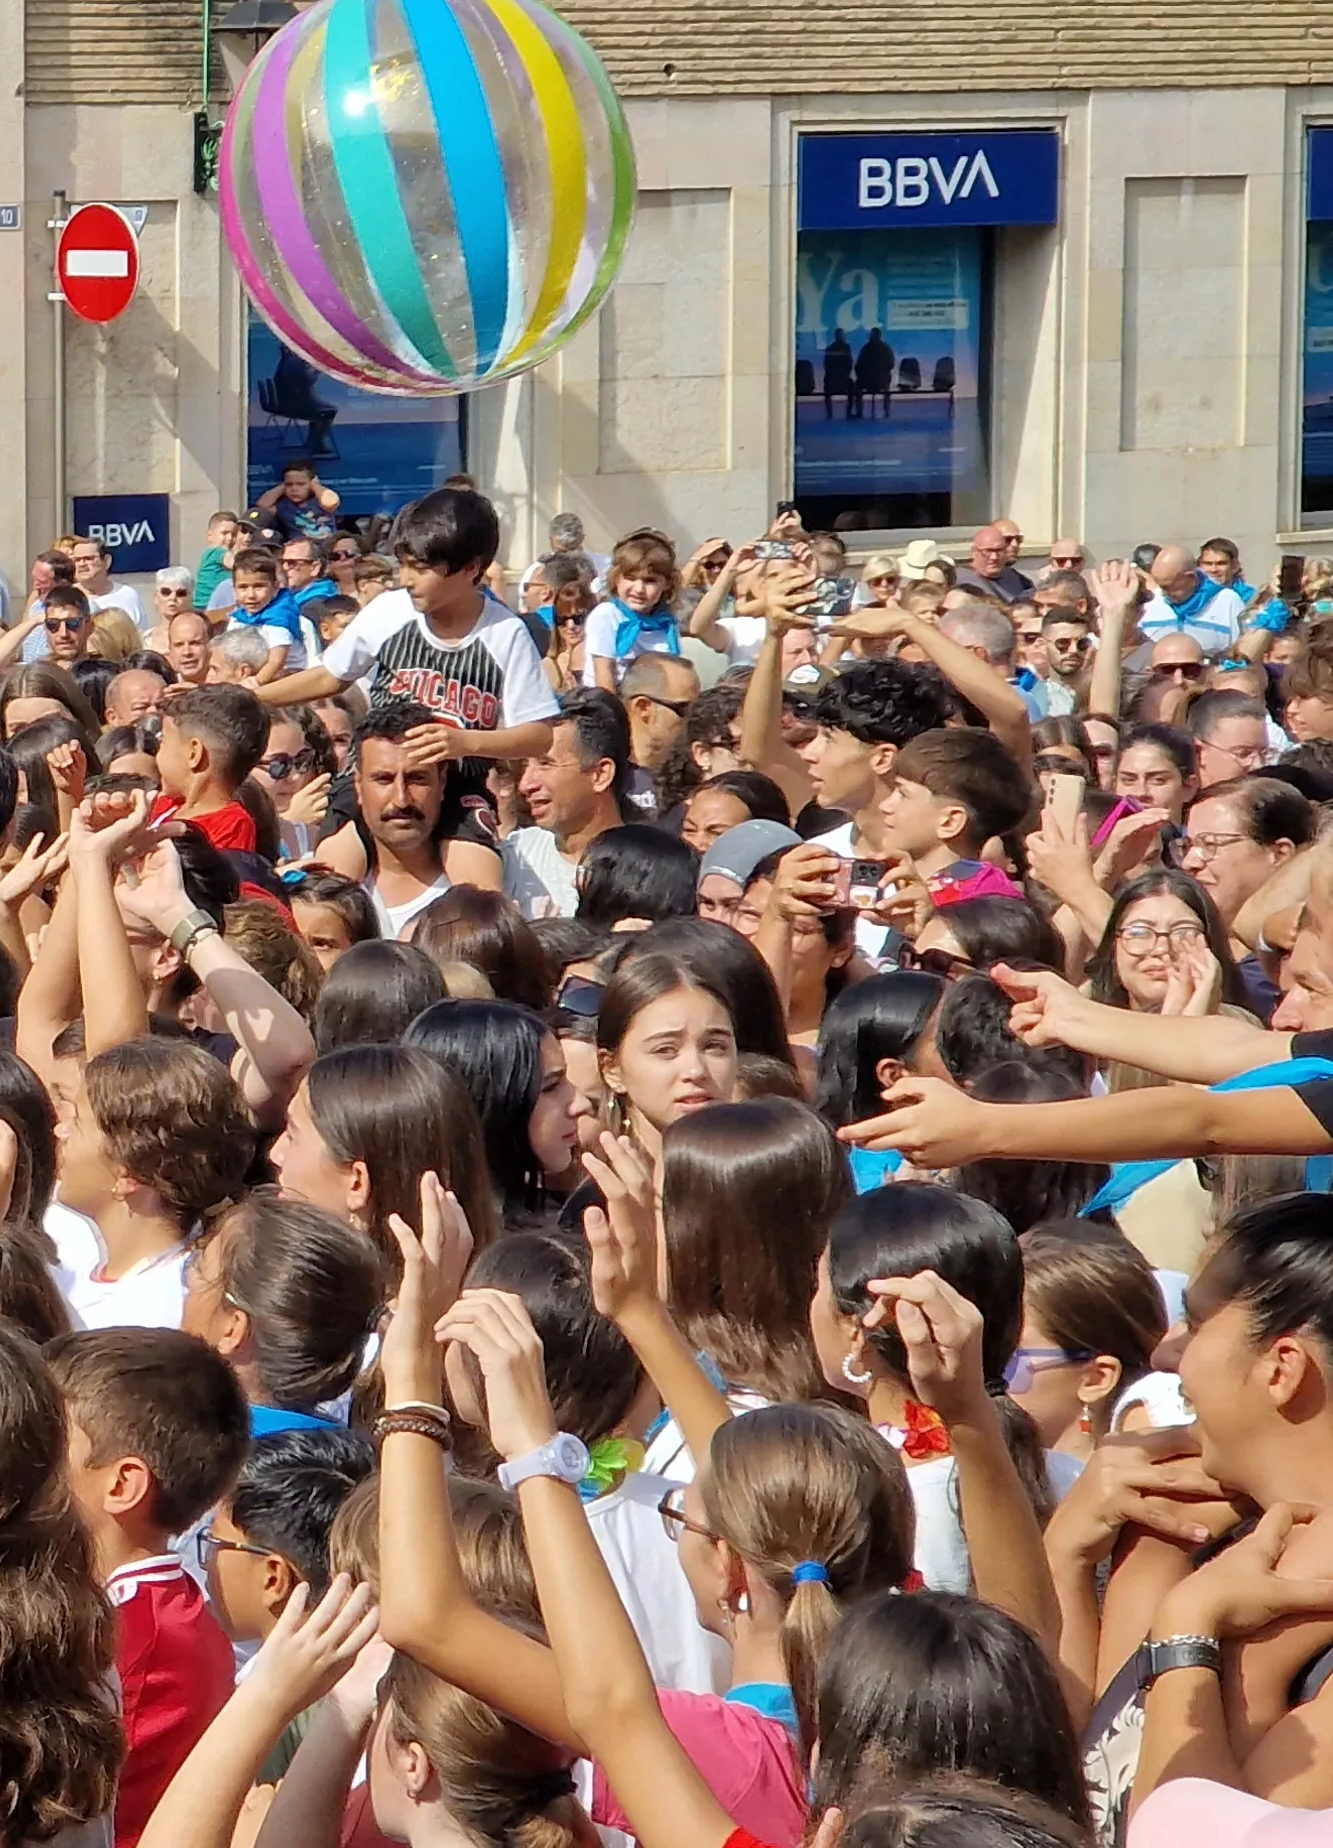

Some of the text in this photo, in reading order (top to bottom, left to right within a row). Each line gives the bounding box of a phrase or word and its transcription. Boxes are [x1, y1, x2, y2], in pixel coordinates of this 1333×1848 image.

[858, 149, 1000, 208] BBVA
[0, 208, 14, 225] 10
[796, 252, 884, 333] Ya
